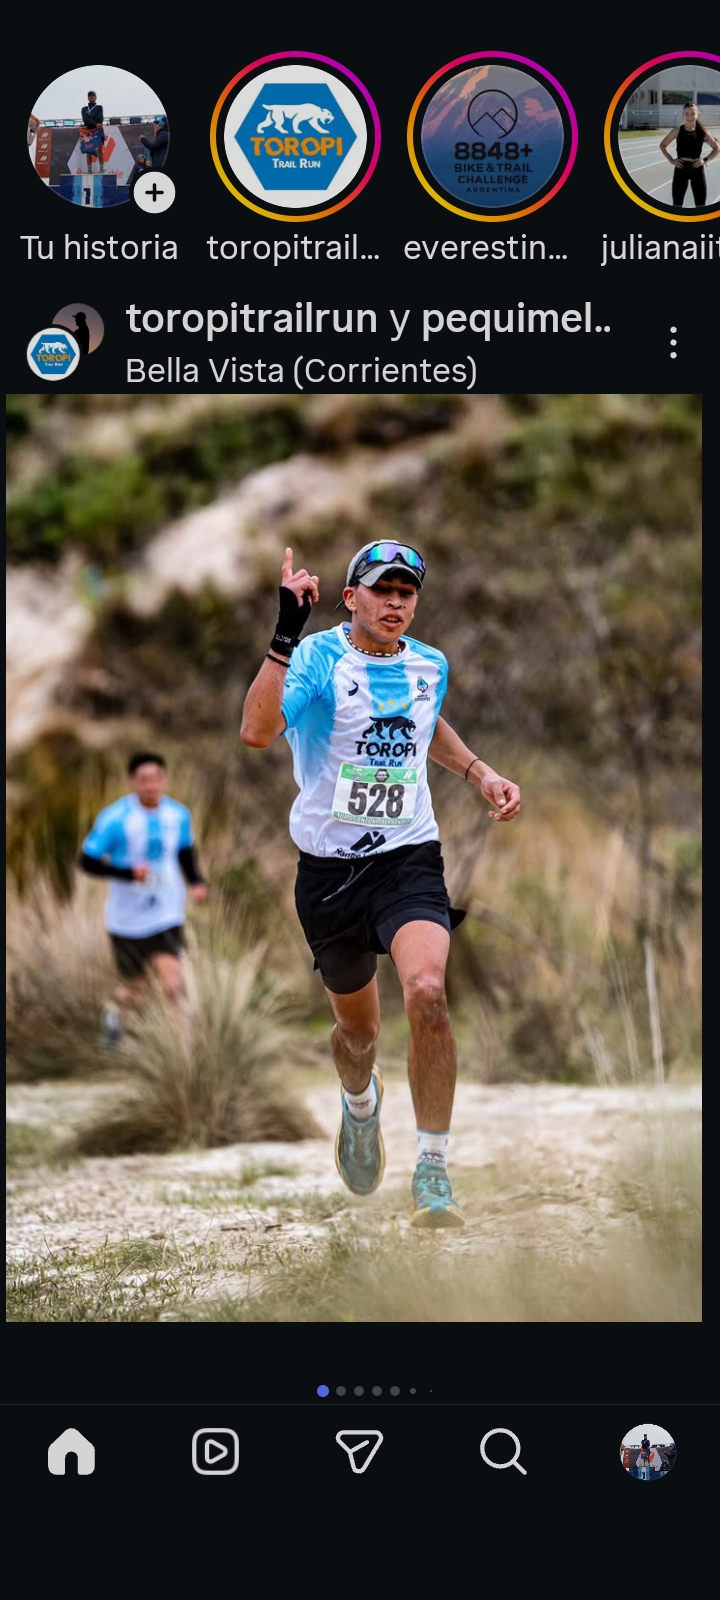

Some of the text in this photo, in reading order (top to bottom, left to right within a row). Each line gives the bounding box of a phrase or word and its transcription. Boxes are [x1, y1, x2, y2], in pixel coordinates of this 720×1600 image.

[250, 137, 343, 156] TOROPI
[454, 142, 533, 160] 8848+
[454, 163, 533, 173] BIKE & TRAIL
[458, 175, 529, 185] CHALLENGE
[466, 186, 521, 194] ARGENTINA
[20, 233, 178, 260] Tu historia
[126, 301, 378, 342] toropitrailrun
[389, 309, 411, 342] y
[36, 353, 71, 363] TOROPI
[126, 355, 477, 391] Bella Vista (Corrientes)
[355, 740, 417, 758] TOROPI
[347, 781, 405, 819] 528
